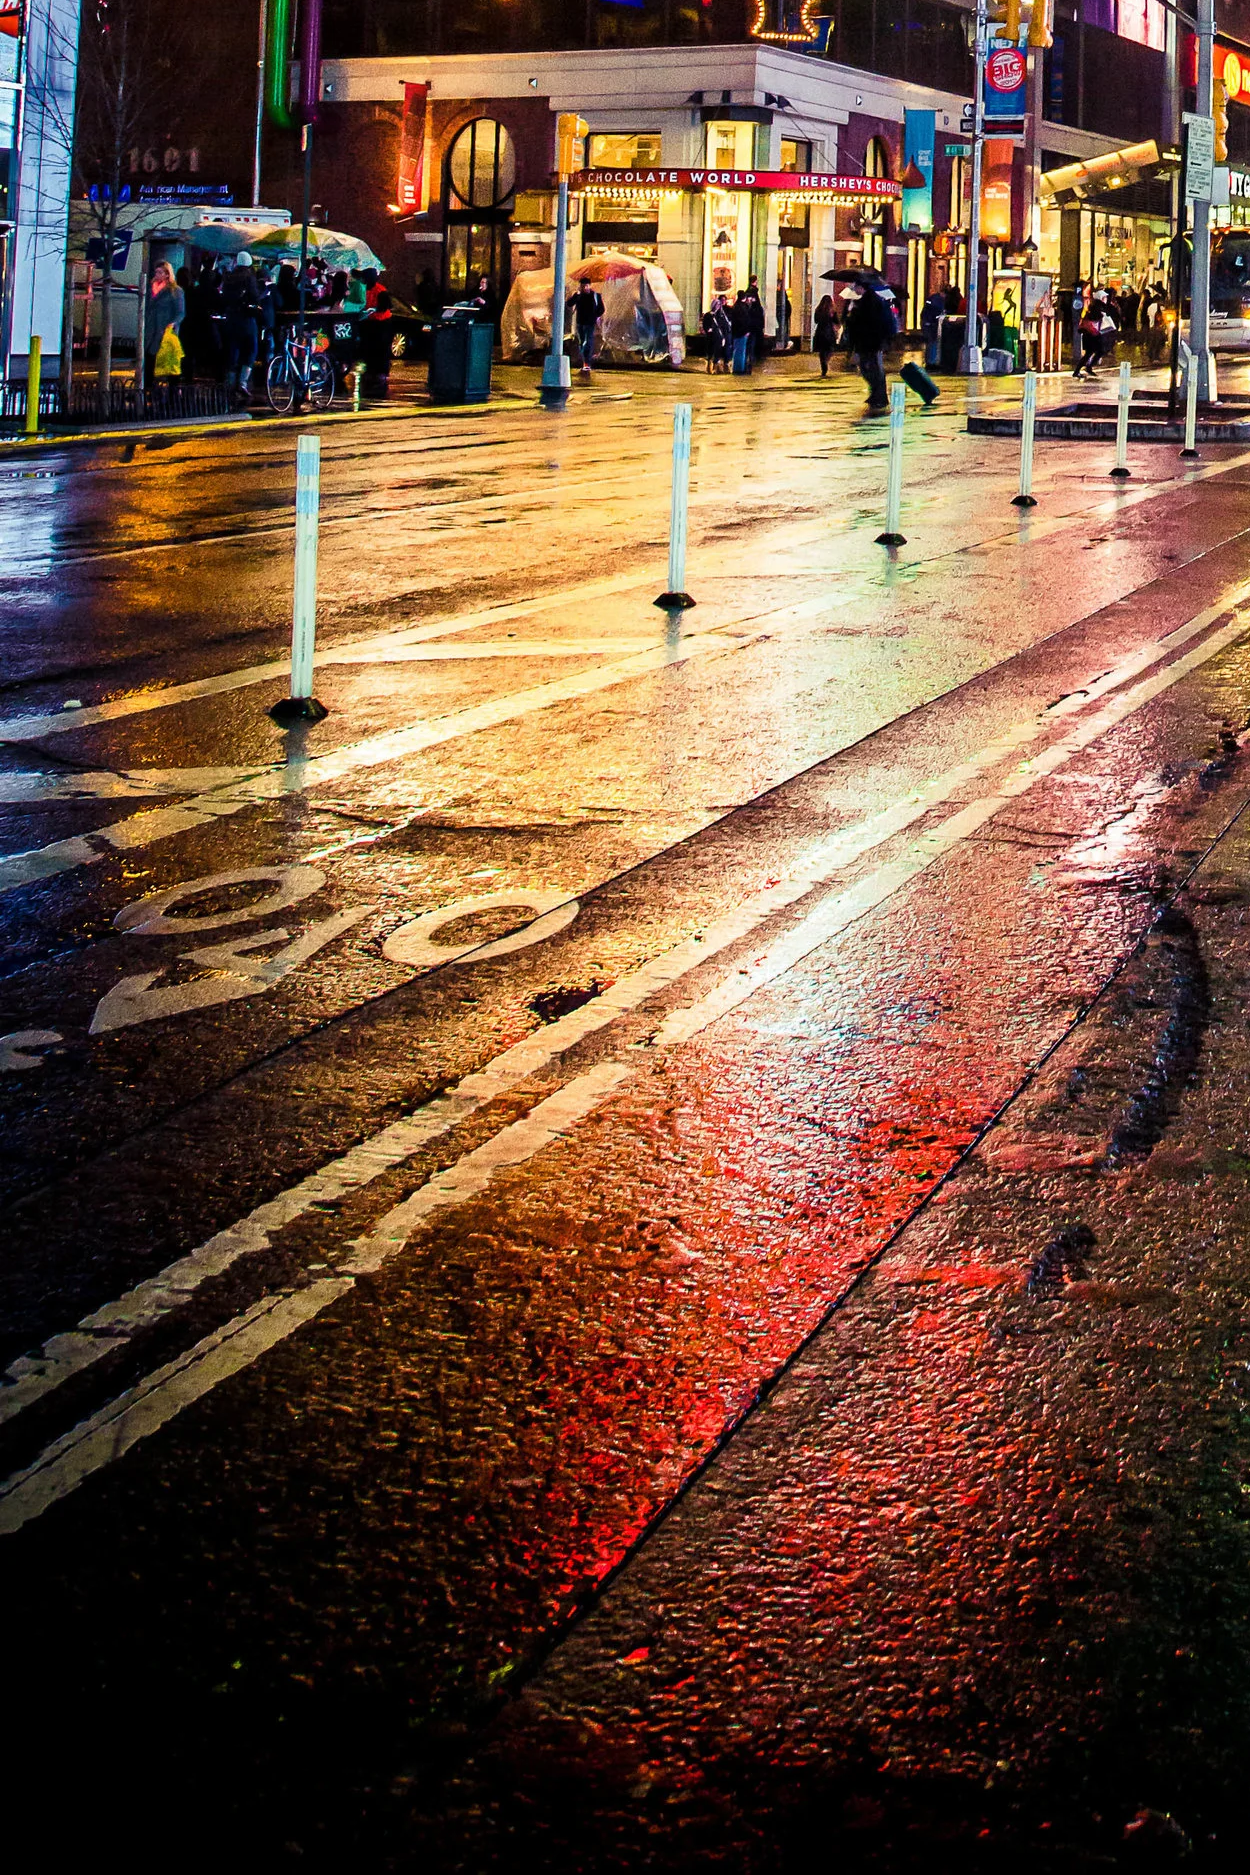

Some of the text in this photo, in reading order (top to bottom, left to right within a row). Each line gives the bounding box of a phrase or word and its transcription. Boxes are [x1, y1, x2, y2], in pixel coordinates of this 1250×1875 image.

[128, 146, 200, 173] 1601
[588, 172, 678, 185] CHOCOLATE
[690, 172, 757, 185] WORLD
[800, 175, 872, 191] HERSHEY'S
